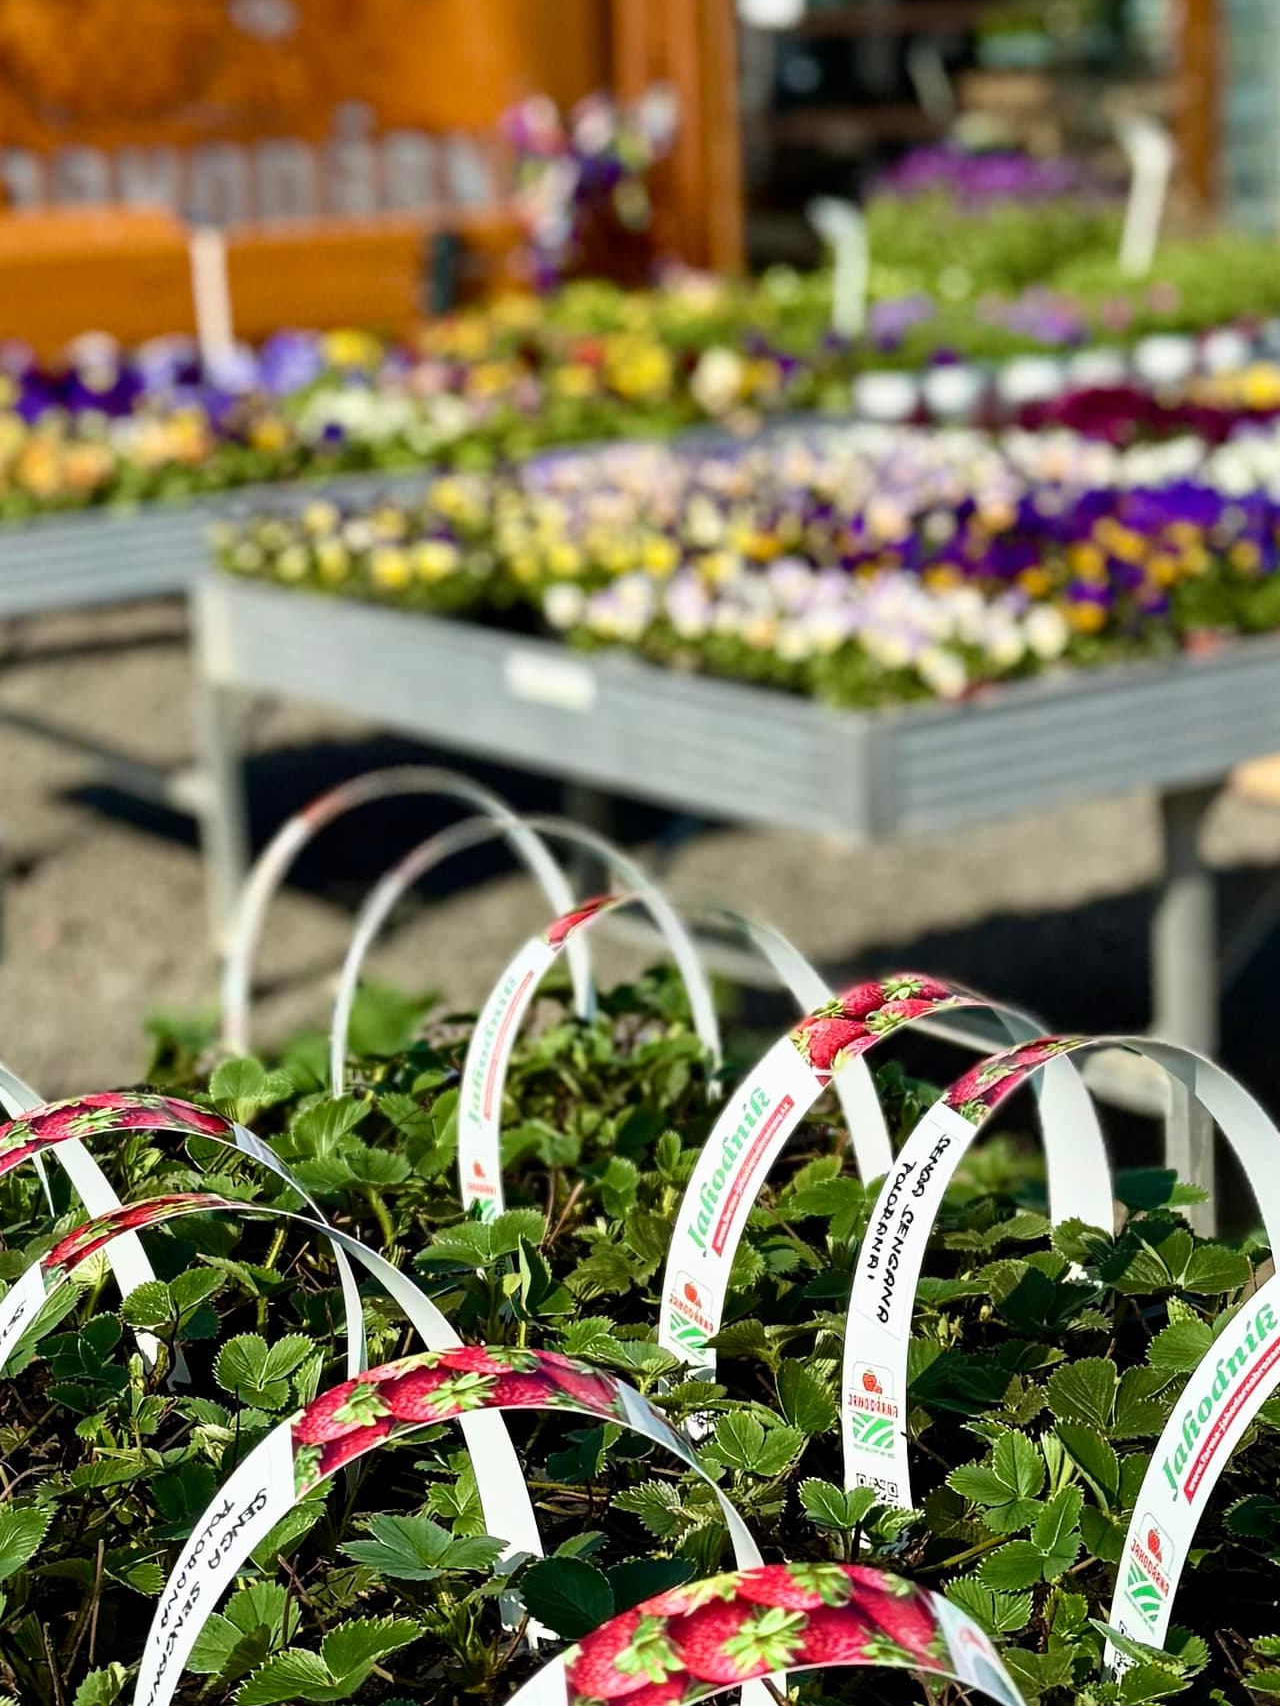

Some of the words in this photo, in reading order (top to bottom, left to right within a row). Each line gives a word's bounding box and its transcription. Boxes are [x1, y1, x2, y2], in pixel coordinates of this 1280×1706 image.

[686, 1086, 772, 1258] Jahodník
[876, 1203, 915, 1324] SENGANA
[1161, 1302, 1280, 1503] Jahodník
[207, 1487, 268, 1570] SENGA
[1129, 1537, 1170, 1598] JAHODÁRNA
